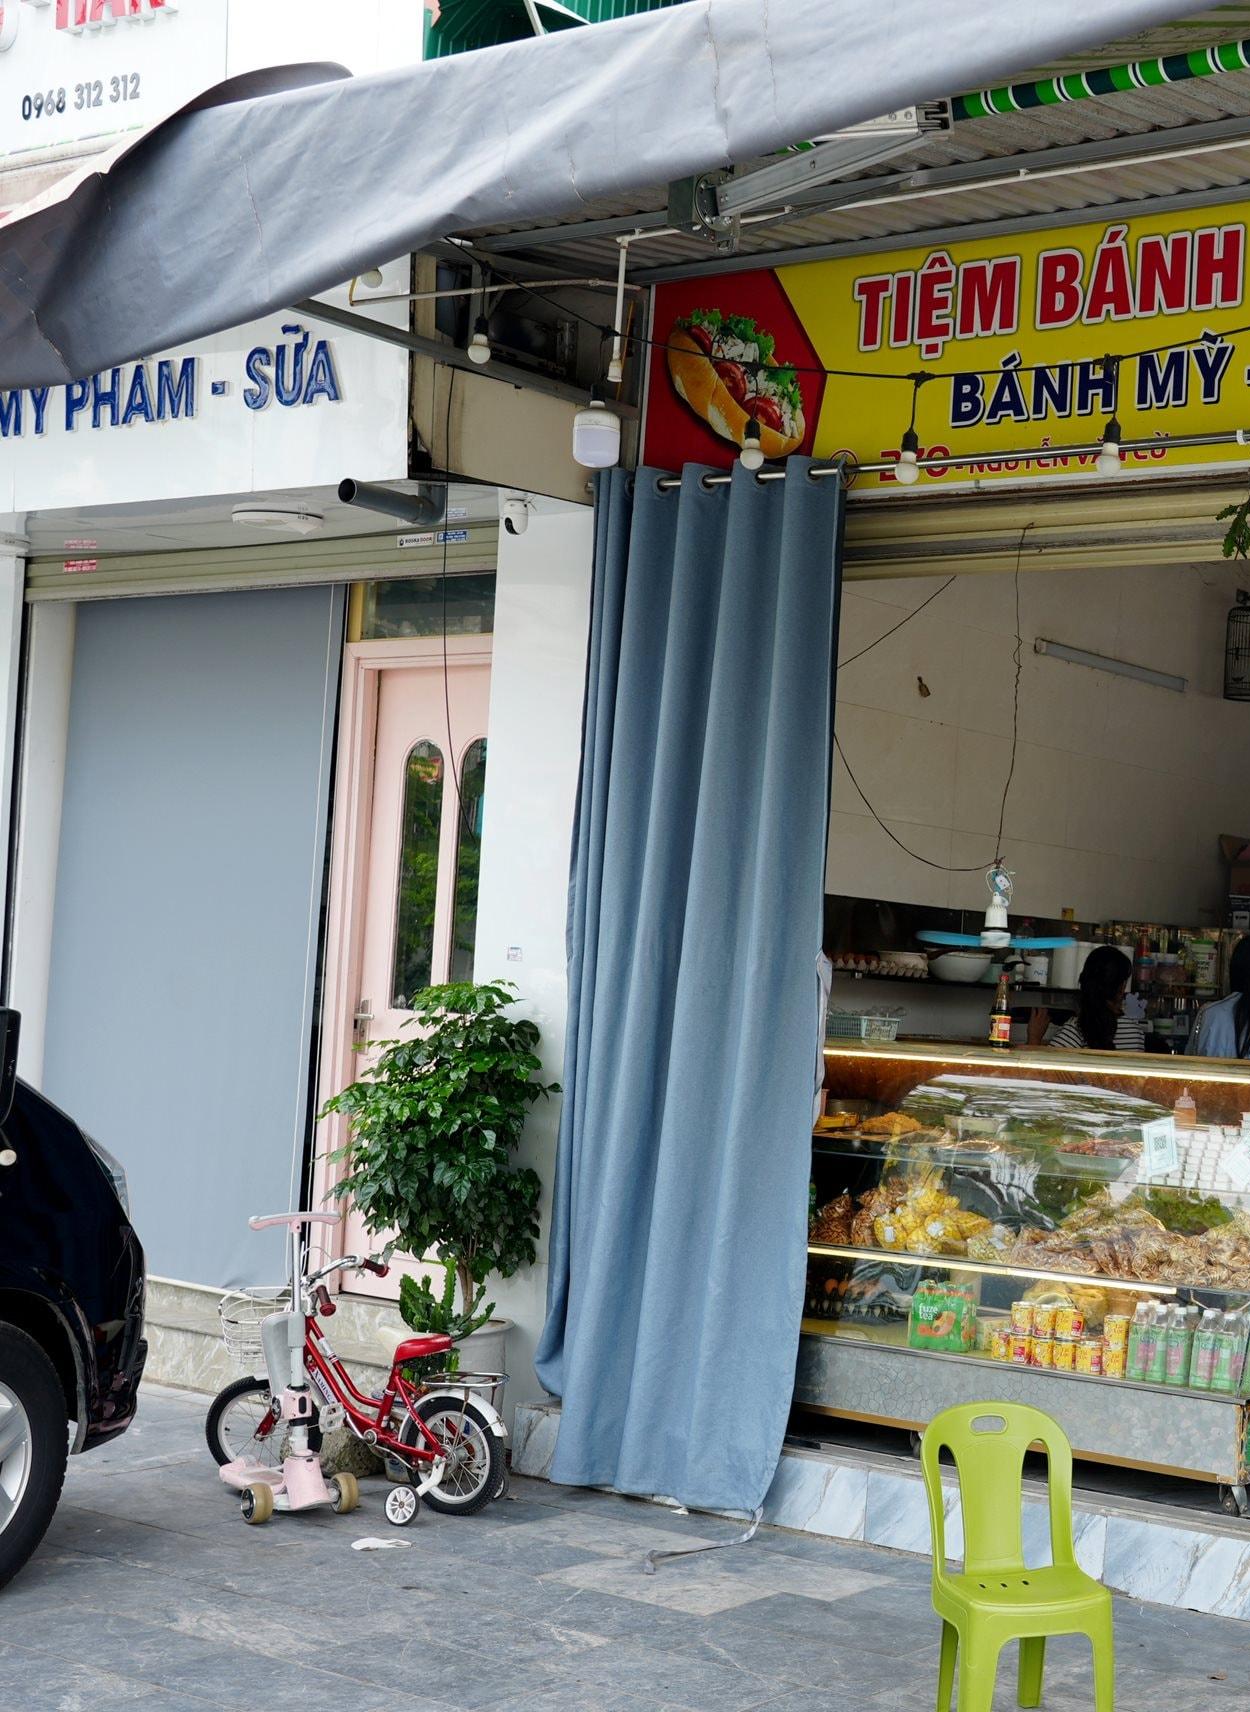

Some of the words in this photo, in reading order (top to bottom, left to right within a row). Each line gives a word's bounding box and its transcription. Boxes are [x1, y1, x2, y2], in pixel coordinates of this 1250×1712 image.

[22, 87, 66, 120] 0968
[74, 80, 103, 110] 312
[110, 72, 140, 103] 312
[855, 251, 1020, 360] TIỆM
[1036, 225, 1245, 331] BÁNH
[243, 324, 342, 410] SỮA
[950, 350, 1117, 427] BÁNH
[1135, 328, 1235, 410] MỲ
[919, 1303, 938, 1313] fuze
[920, 1311, 933, 1321] tea
